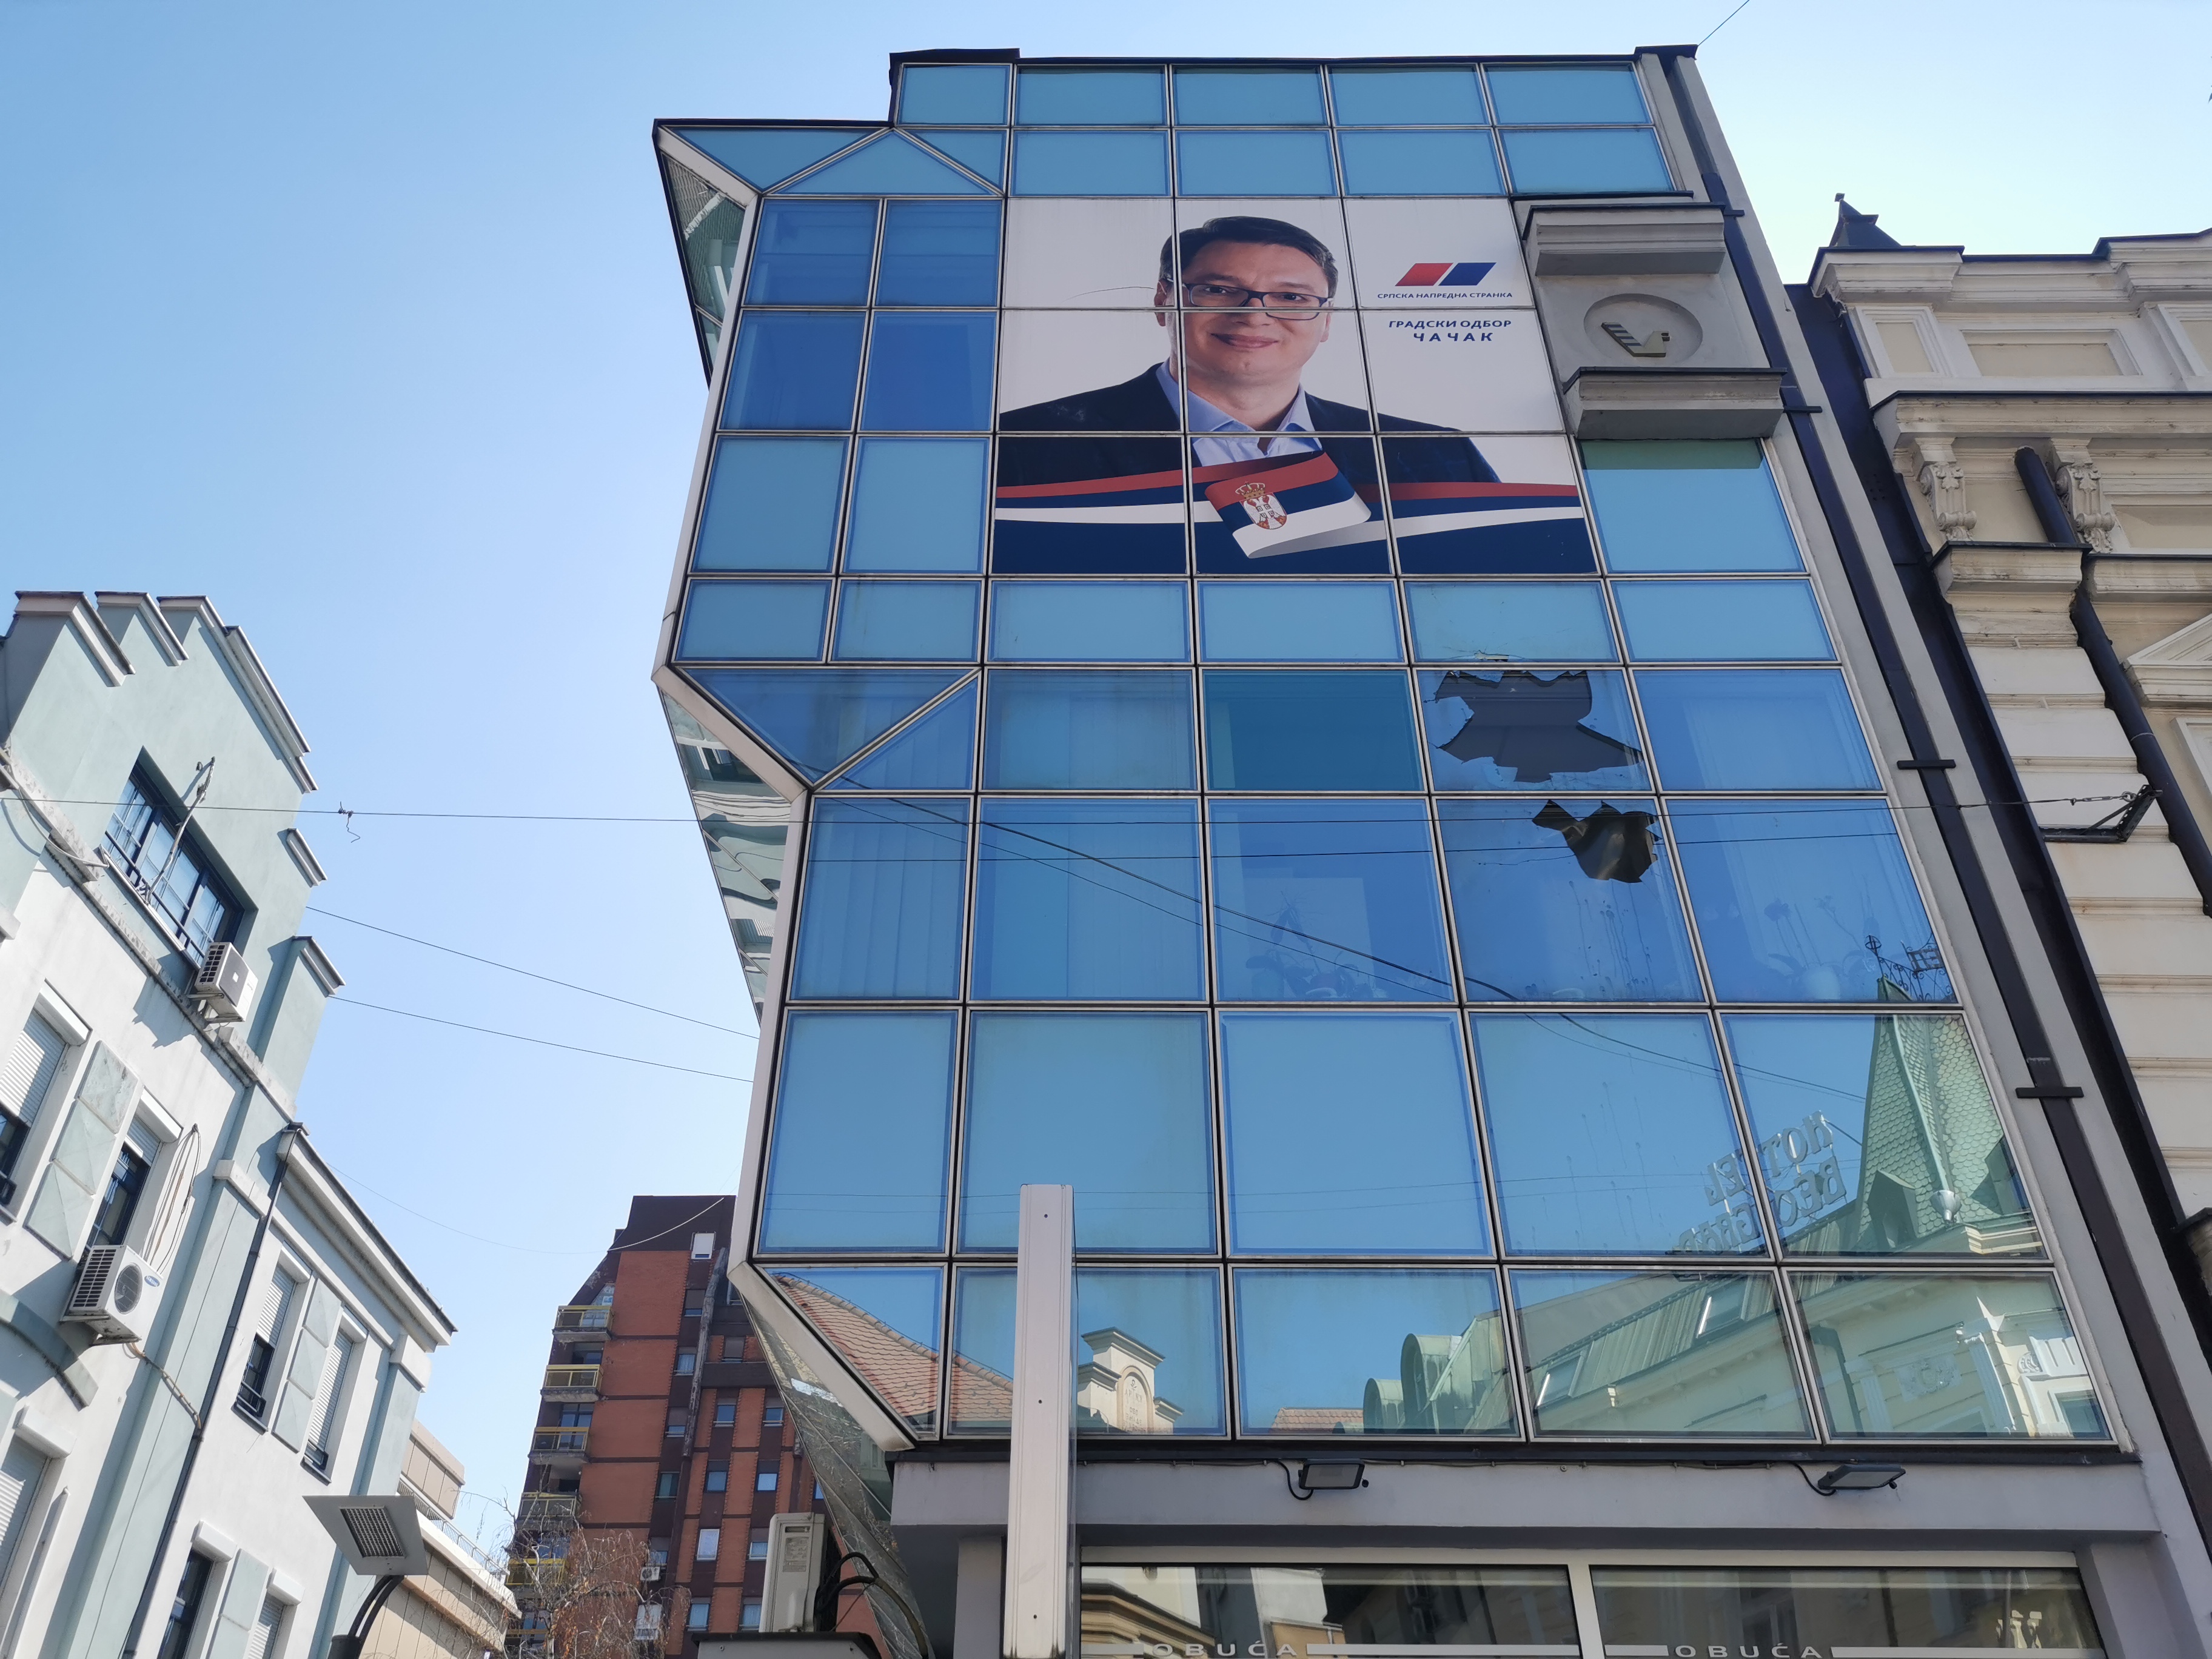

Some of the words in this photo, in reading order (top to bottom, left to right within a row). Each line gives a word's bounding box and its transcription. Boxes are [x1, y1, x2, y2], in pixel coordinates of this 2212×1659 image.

[1389, 320, 1457, 330] ГРАДСКИ
[1460, 320, 1512, 329] ОДБОР
[1413, 332, 1493, 342] ЧАЧАК
[1153, 1640, 1298, 1657] OBUĆA
[1675, 1642, 1823, 1658] OBUĆA
